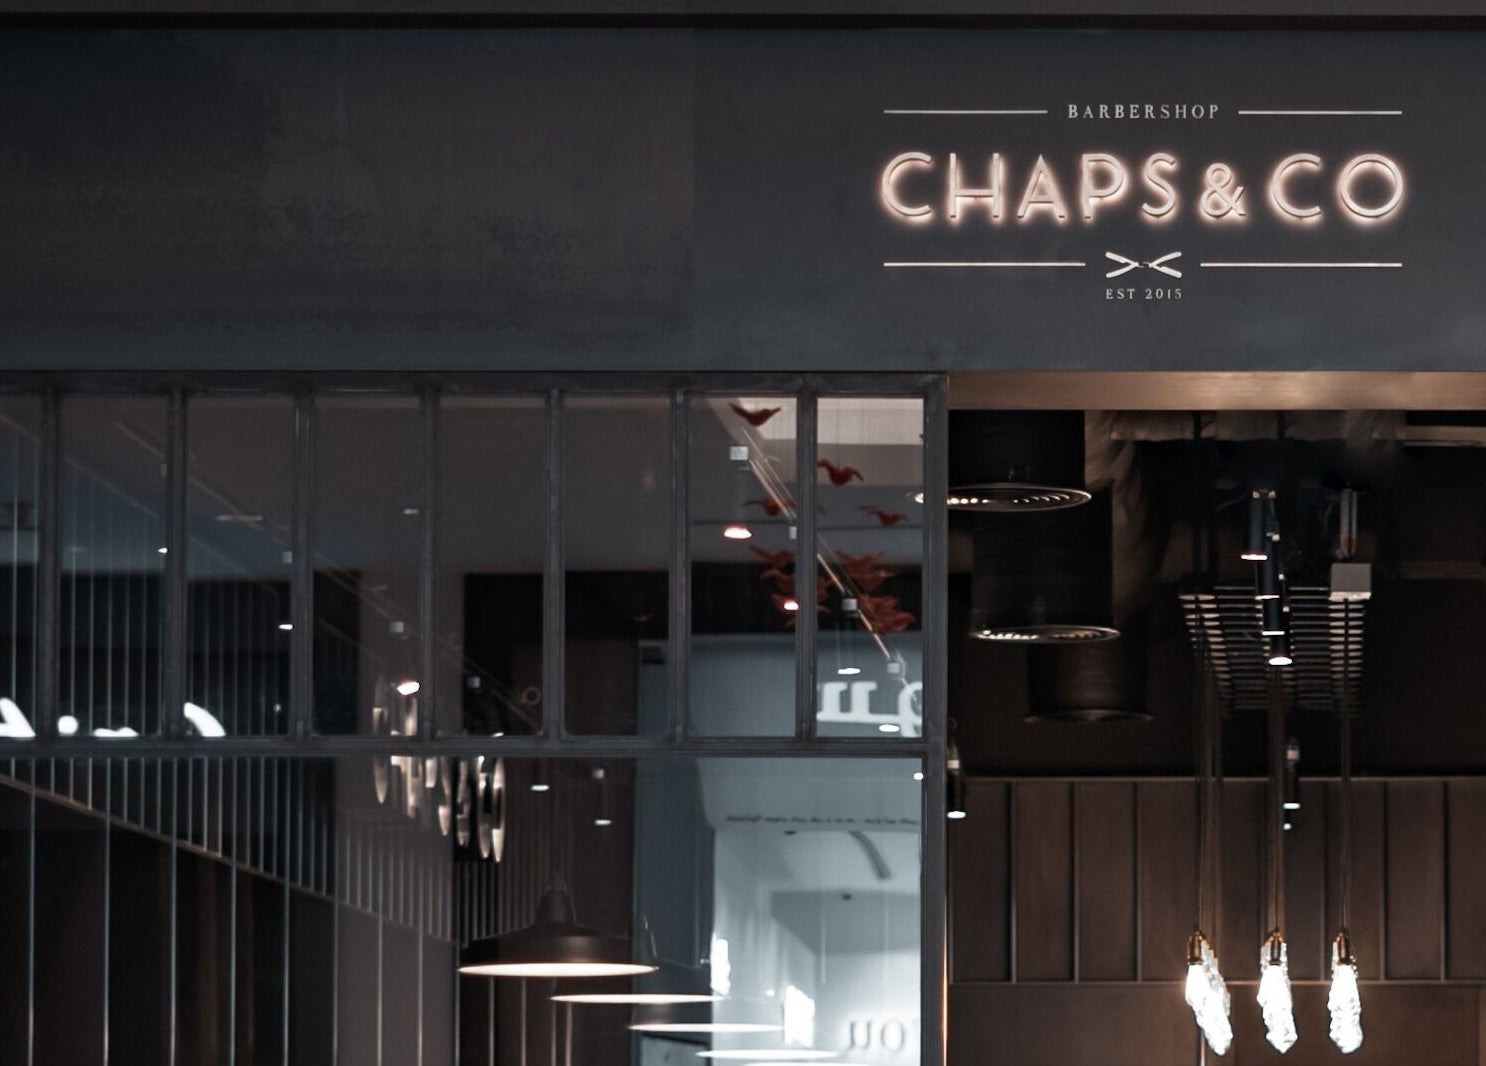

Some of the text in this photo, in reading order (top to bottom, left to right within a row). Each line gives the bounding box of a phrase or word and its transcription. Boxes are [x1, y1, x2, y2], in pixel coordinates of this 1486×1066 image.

[1067, 104, 1220, 119] BARBERSHOP
[1105, 288, 1182, 300] EST 2015
